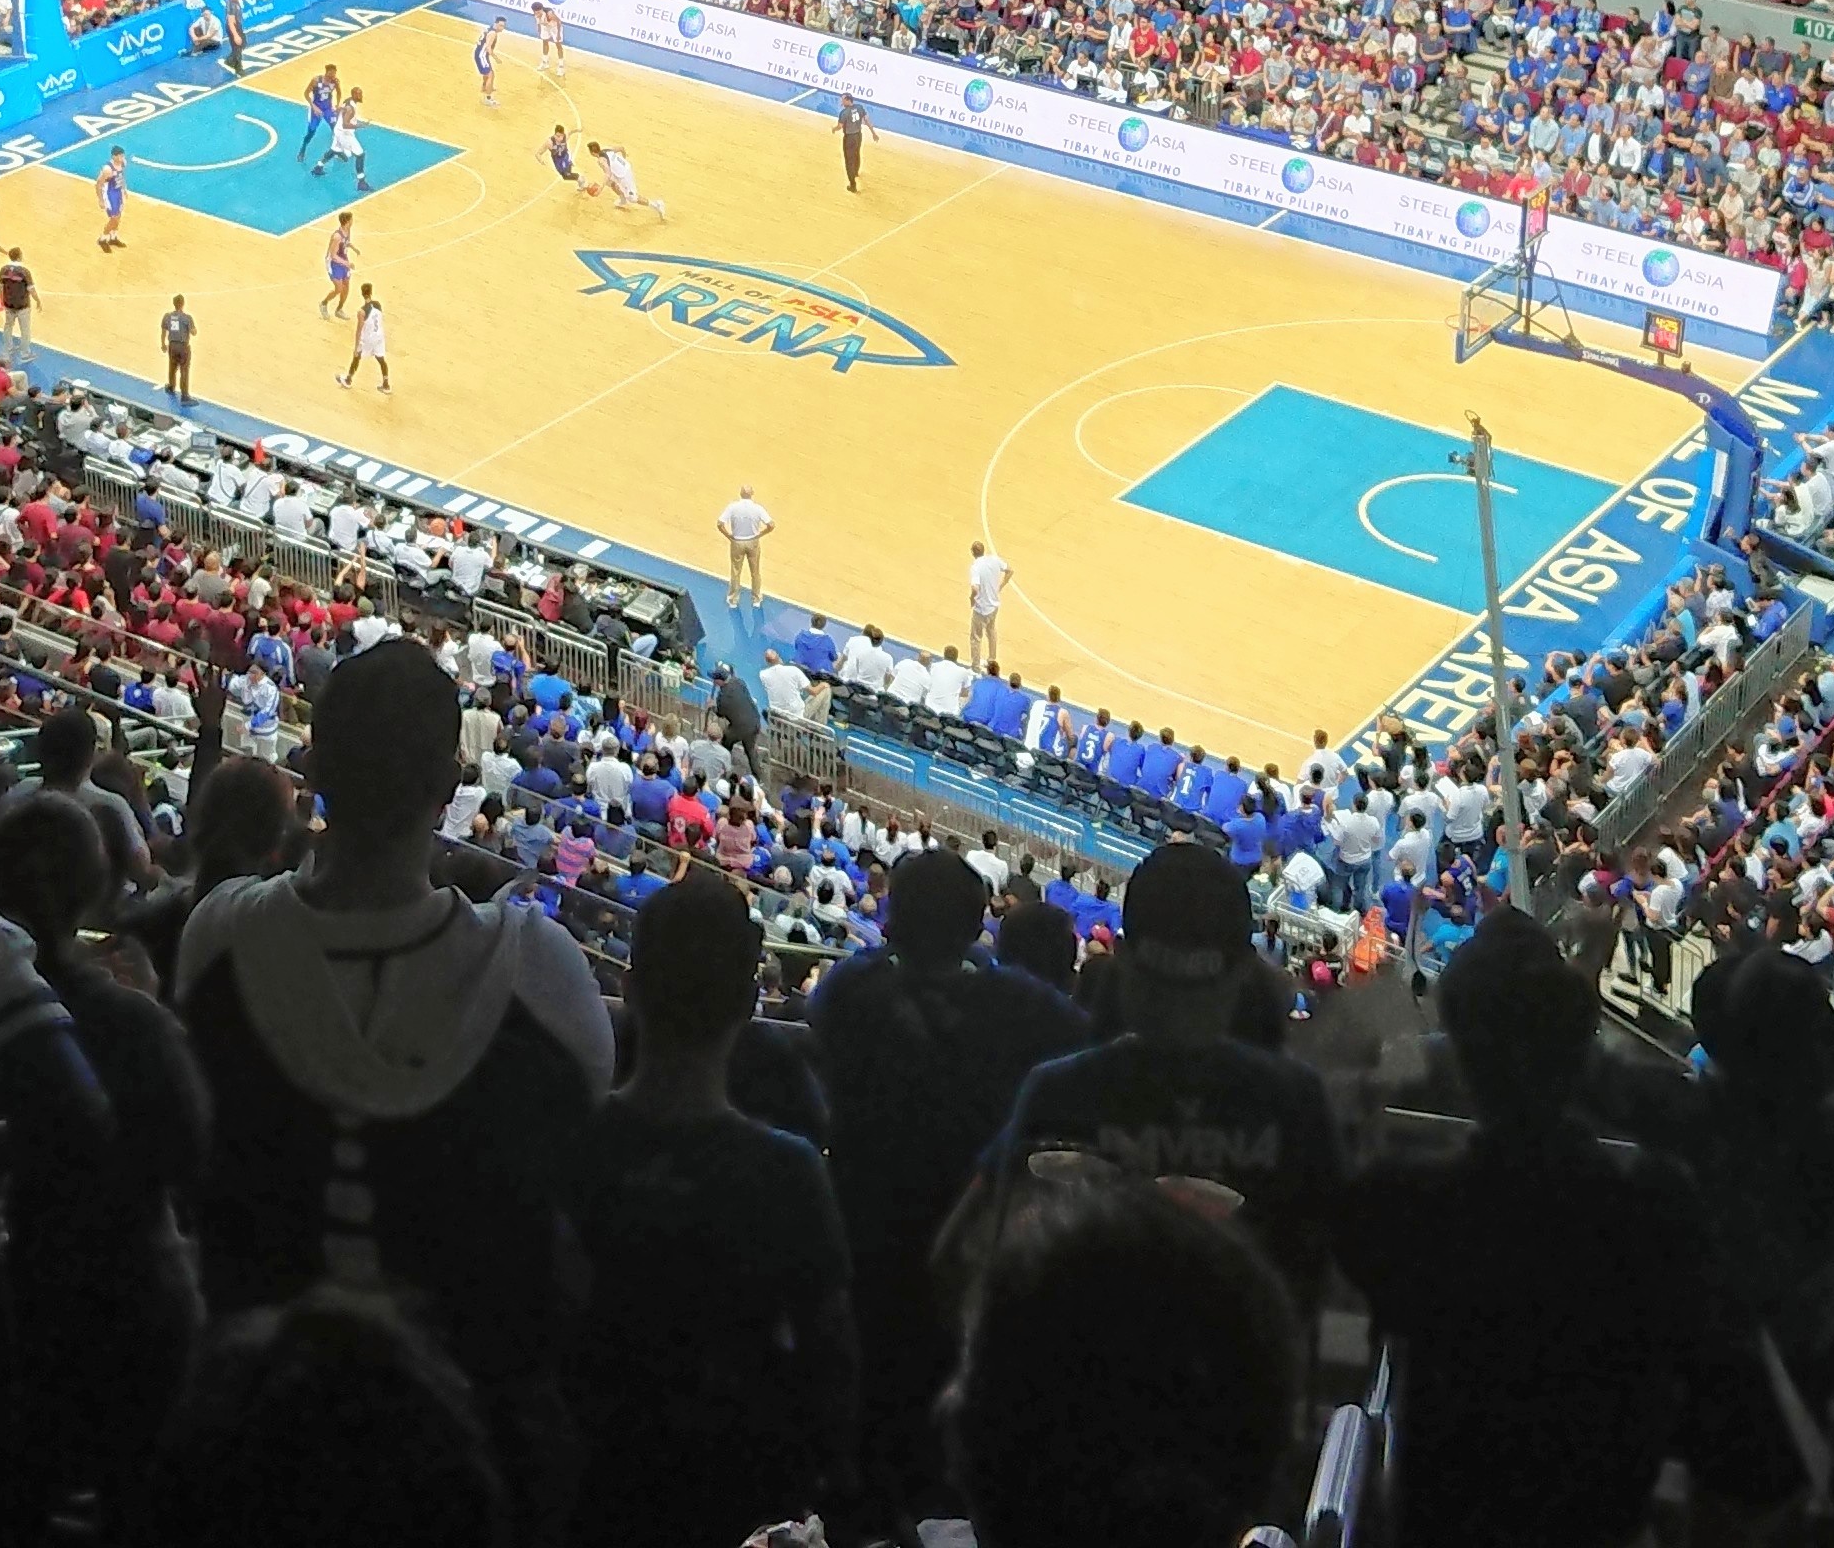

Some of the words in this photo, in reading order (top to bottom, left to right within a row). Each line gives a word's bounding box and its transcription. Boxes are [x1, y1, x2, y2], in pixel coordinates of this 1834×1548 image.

[107, 22, 165, 57] vivo
[634, 3, 676, 25] STEEL
[705, 20, 738, 39] ASIA
[630, 26, 661, 46] TIBAY
[664, 36, 680, 49] NG
[684, 39, 733, 62] PILIPINO
[771, 38, 815, 60] STEEL
[845, 56, 879, 75] ASIA
[36, 68, 78, 94] vivo
[71, 77, 214, 140] ASIA
[217, 8, 398, 79] ARENA
[766, 61, 799, 81] TIBAY
[803, 70, 819, 85] NG
[822, 74, 874, 98] PILIPINO
[915, 74, 961, 97] STEEL
[993, 94, 1029, 113] ASIA
[910, 98, 945, 119] TIBAY
[949, 108, 966, 124] NG
[969, 114, 1025, 138] PILIPINO
[1067, 113, 1116, 136] STEEL
[1149, 134, 1187, 153] ASIA
[1063, 138, 1100, 160] TIBAY
[1102, 148, 1121, 163] NG
[1124, 154, 1182, 178] PILIPINO
[1228, 153, 1279, 177] STEEL
[1316, 174, 1354, 195] ASIA
[1222, 178, 1261, 201] TIBAY
[1265, 189, 1284, 205] NG
[1288, 195, 1350, 221] PILIPINO
[1398, 193, 1452, 220] STEEL
[1393, 221, 1432, 244] TIBAY
[1438, 233, 1458, 248] NG
[1580, 241, 1639, 269] STEEL
[1680, 267, 1725, 291] ASIA
[676, 269, 737, 293] MALL
[770, 297, 862, 330] ASIA
[1575, 269, 1618, 291] TIBAY
[1624, 281, 1646, 298] NG
[1651, 288, 1720, 318] PILIPINO
[576, 270, 869, 375] ARENA
[1626, 477, 1698, 533] OF
[1501, 527, 1644, 623] ASIA
[1082, 738, 1096, 761] 3
[1180, 774, 1192, 795] 1
